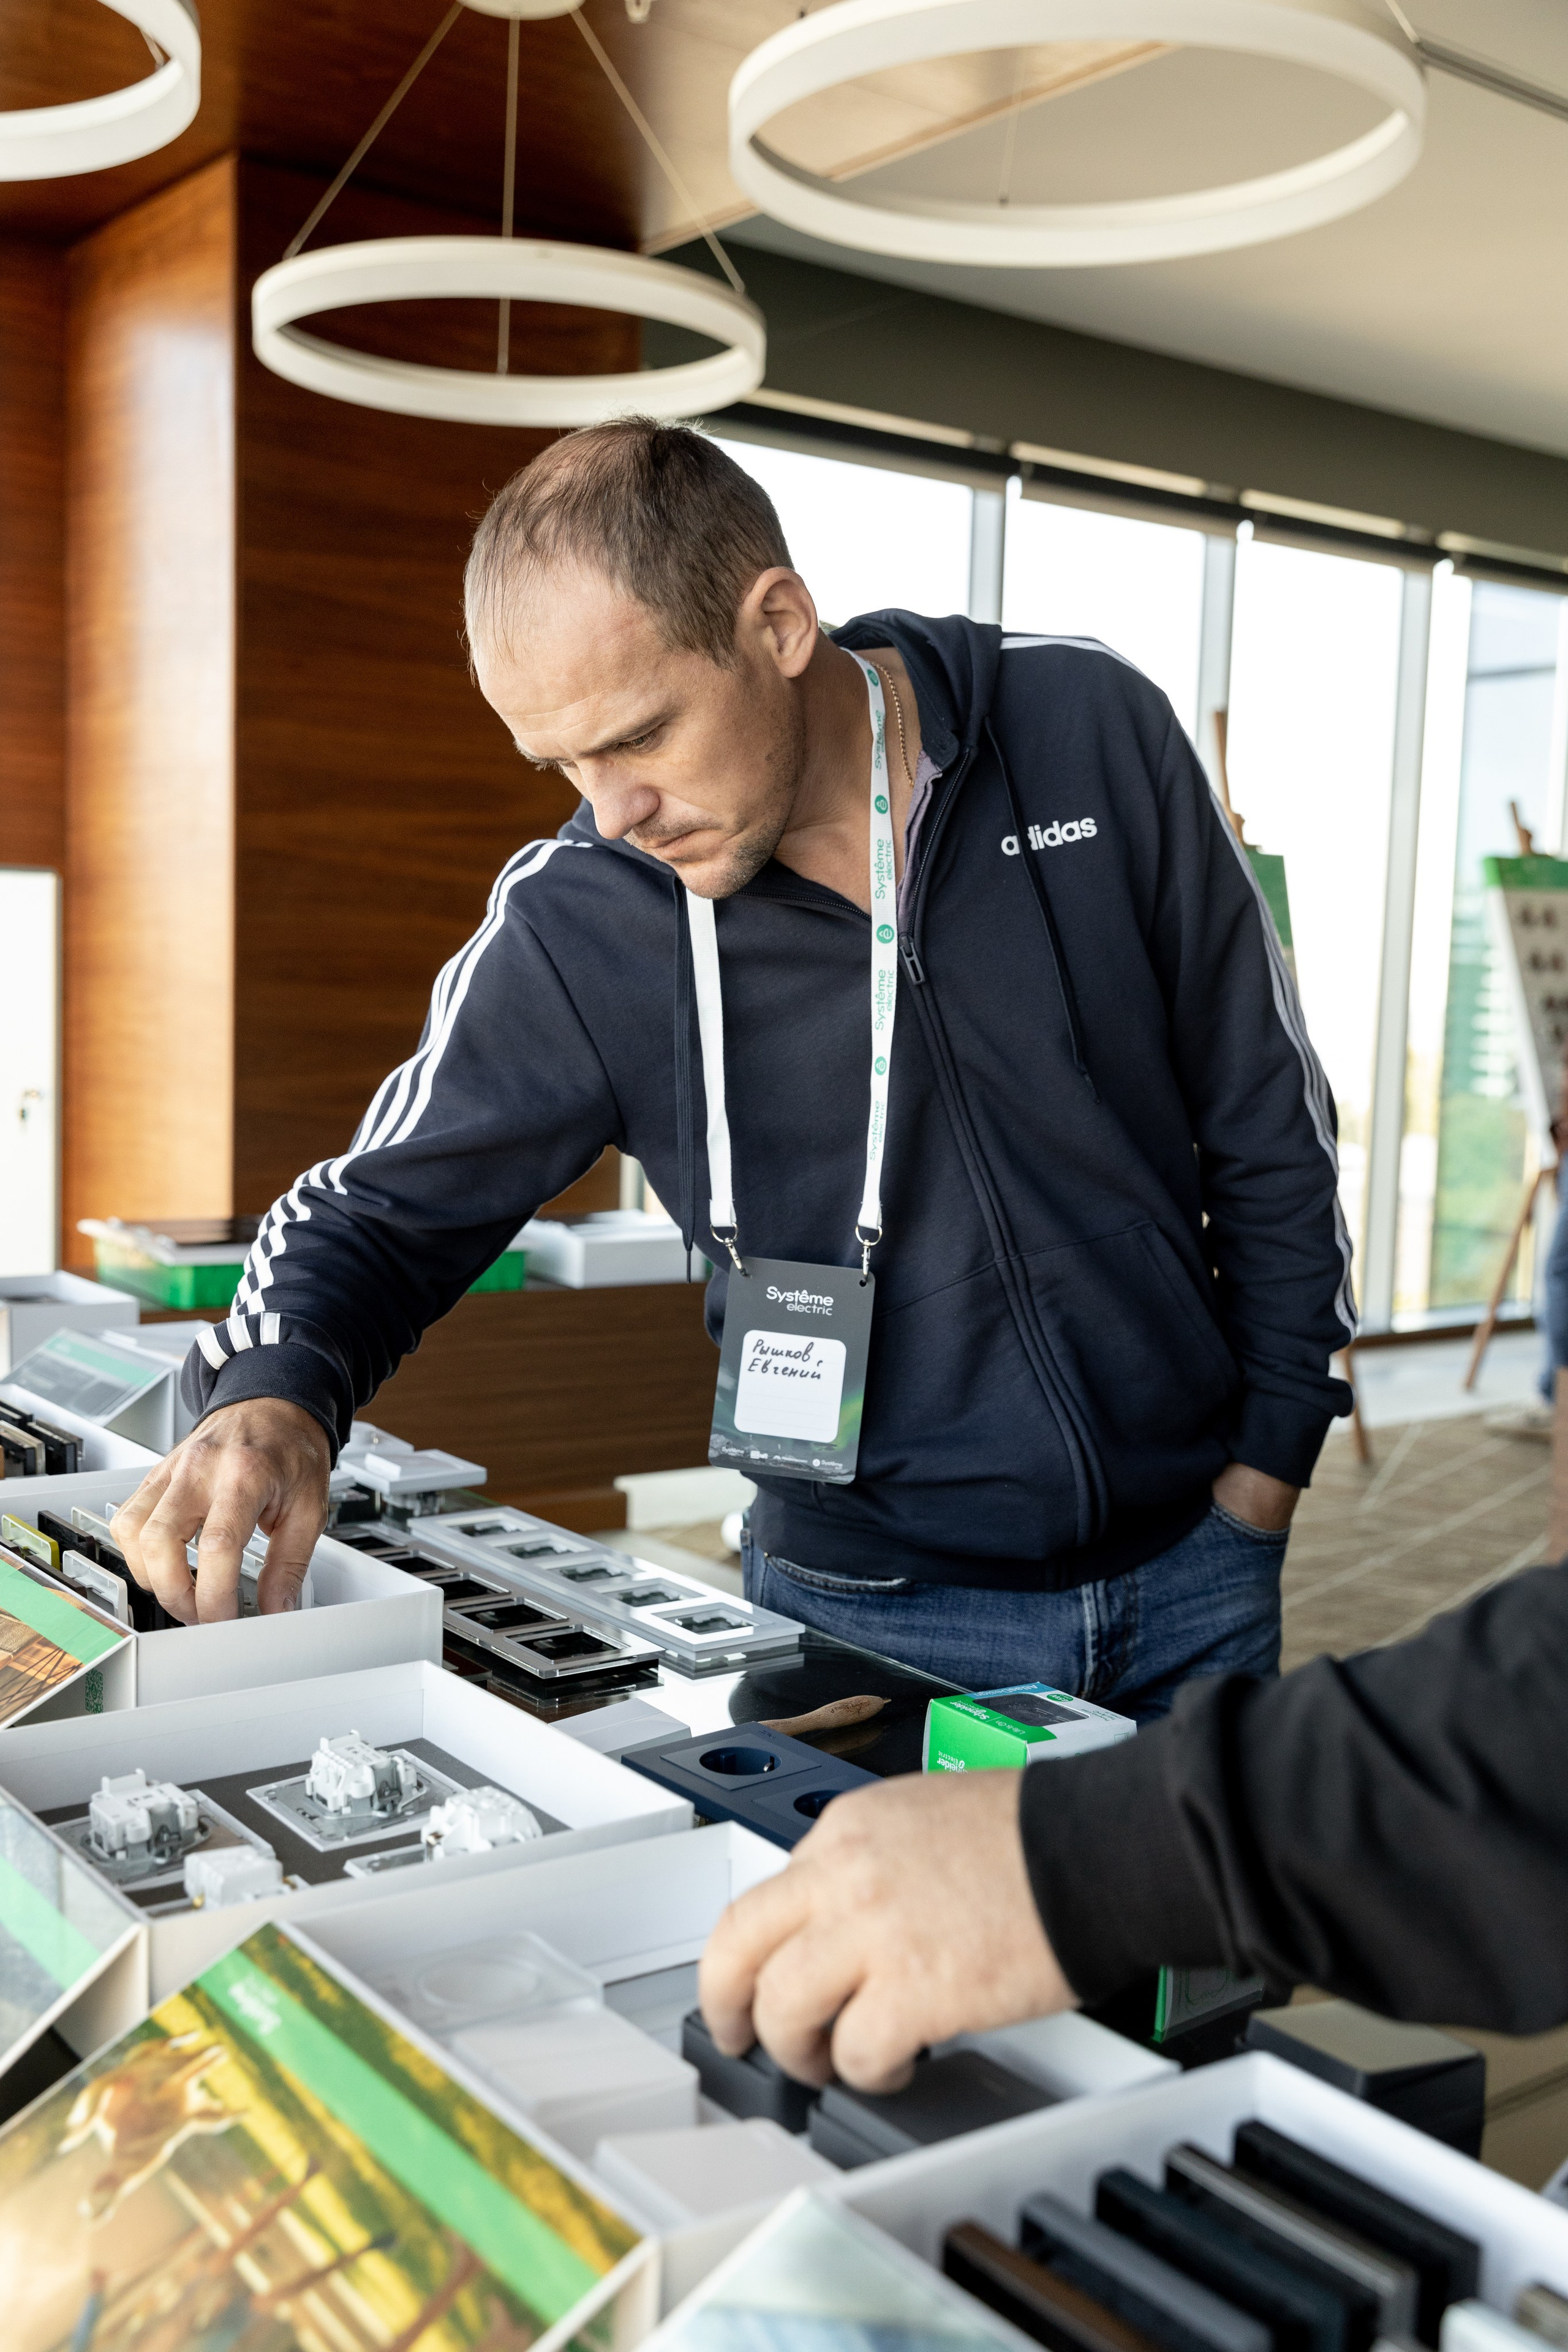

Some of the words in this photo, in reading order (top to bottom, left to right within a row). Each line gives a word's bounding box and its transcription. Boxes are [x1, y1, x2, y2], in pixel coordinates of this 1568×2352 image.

[874, 839, 887, 900] Systême
[884, 839, 893, 880] electric
[875, 970, 886, 1031] Systême
[886, 970, 895, 1012] electric
[869, 1101, 880, 1161] Systême
[766, 1286, 834, 1306] Systême
[786, 1302, 833, 1316] electric
[949, 1702, 990, 1720] Schneider
[938, 1751, 959, 1765] Electric
